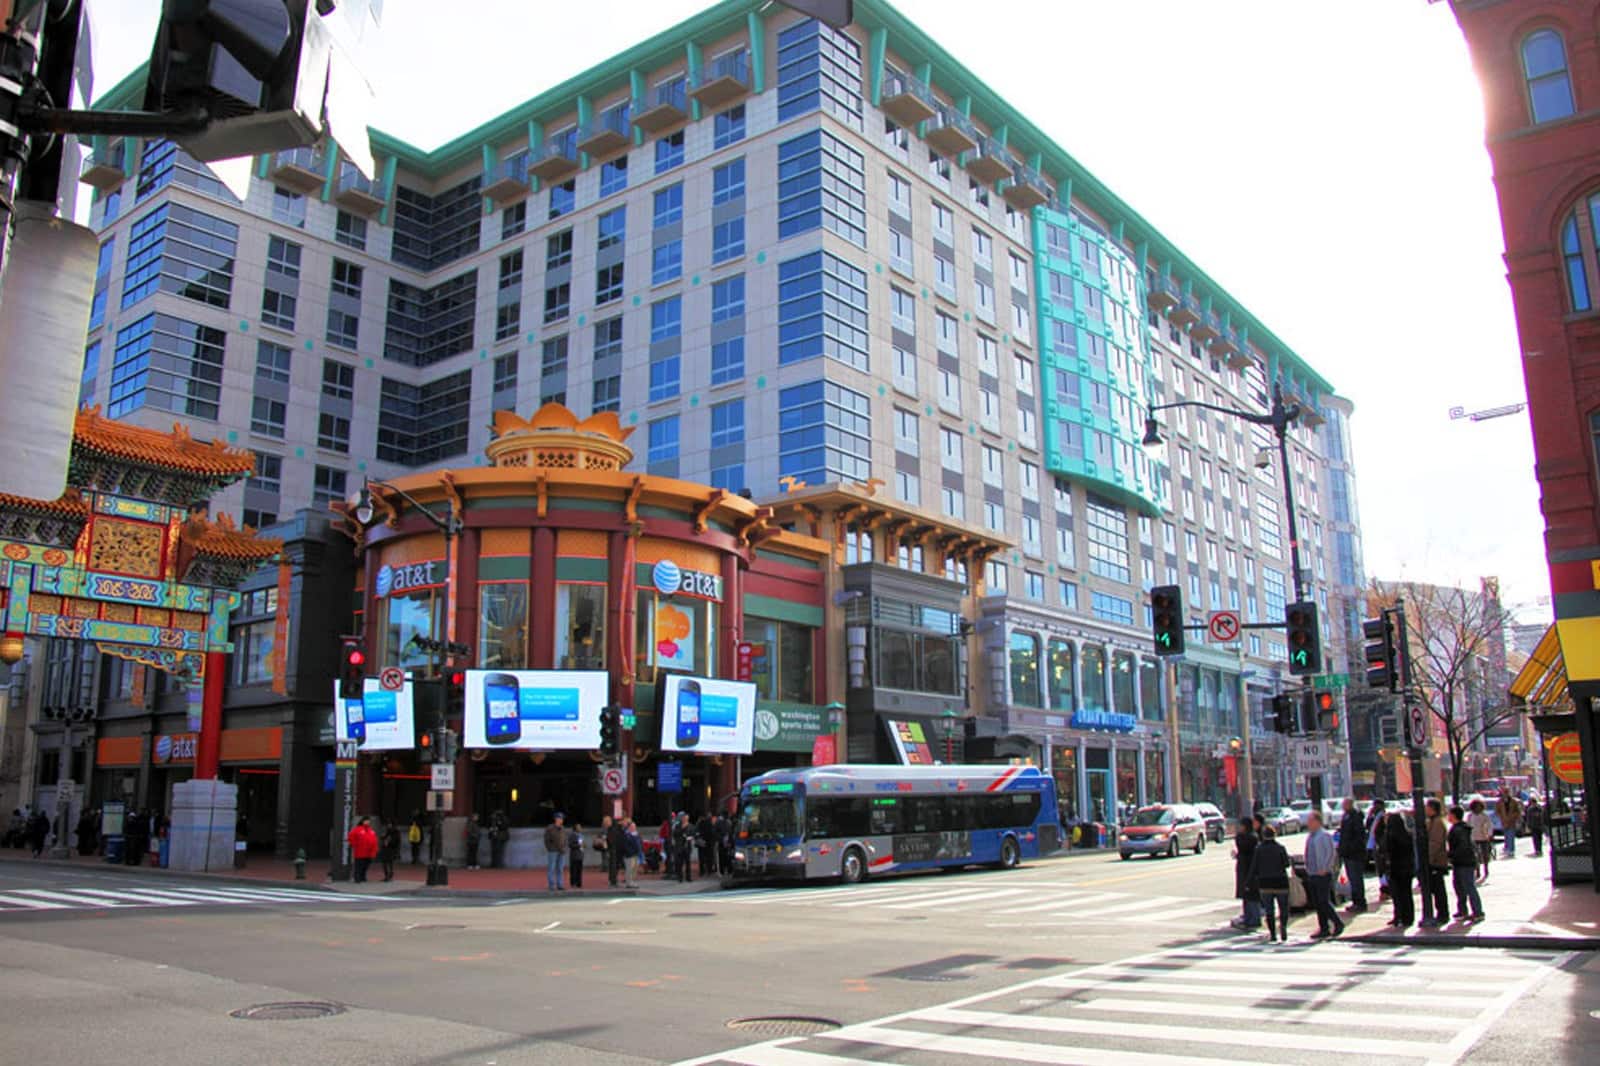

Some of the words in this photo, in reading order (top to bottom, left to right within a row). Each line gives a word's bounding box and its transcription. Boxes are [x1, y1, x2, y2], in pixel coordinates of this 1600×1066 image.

[394, 561, 435, 590] at&t
[683, 570, 720, 599] at&t
[172, 737, 198, 758] at&t
[1303, 745, 1319, 755] NO
